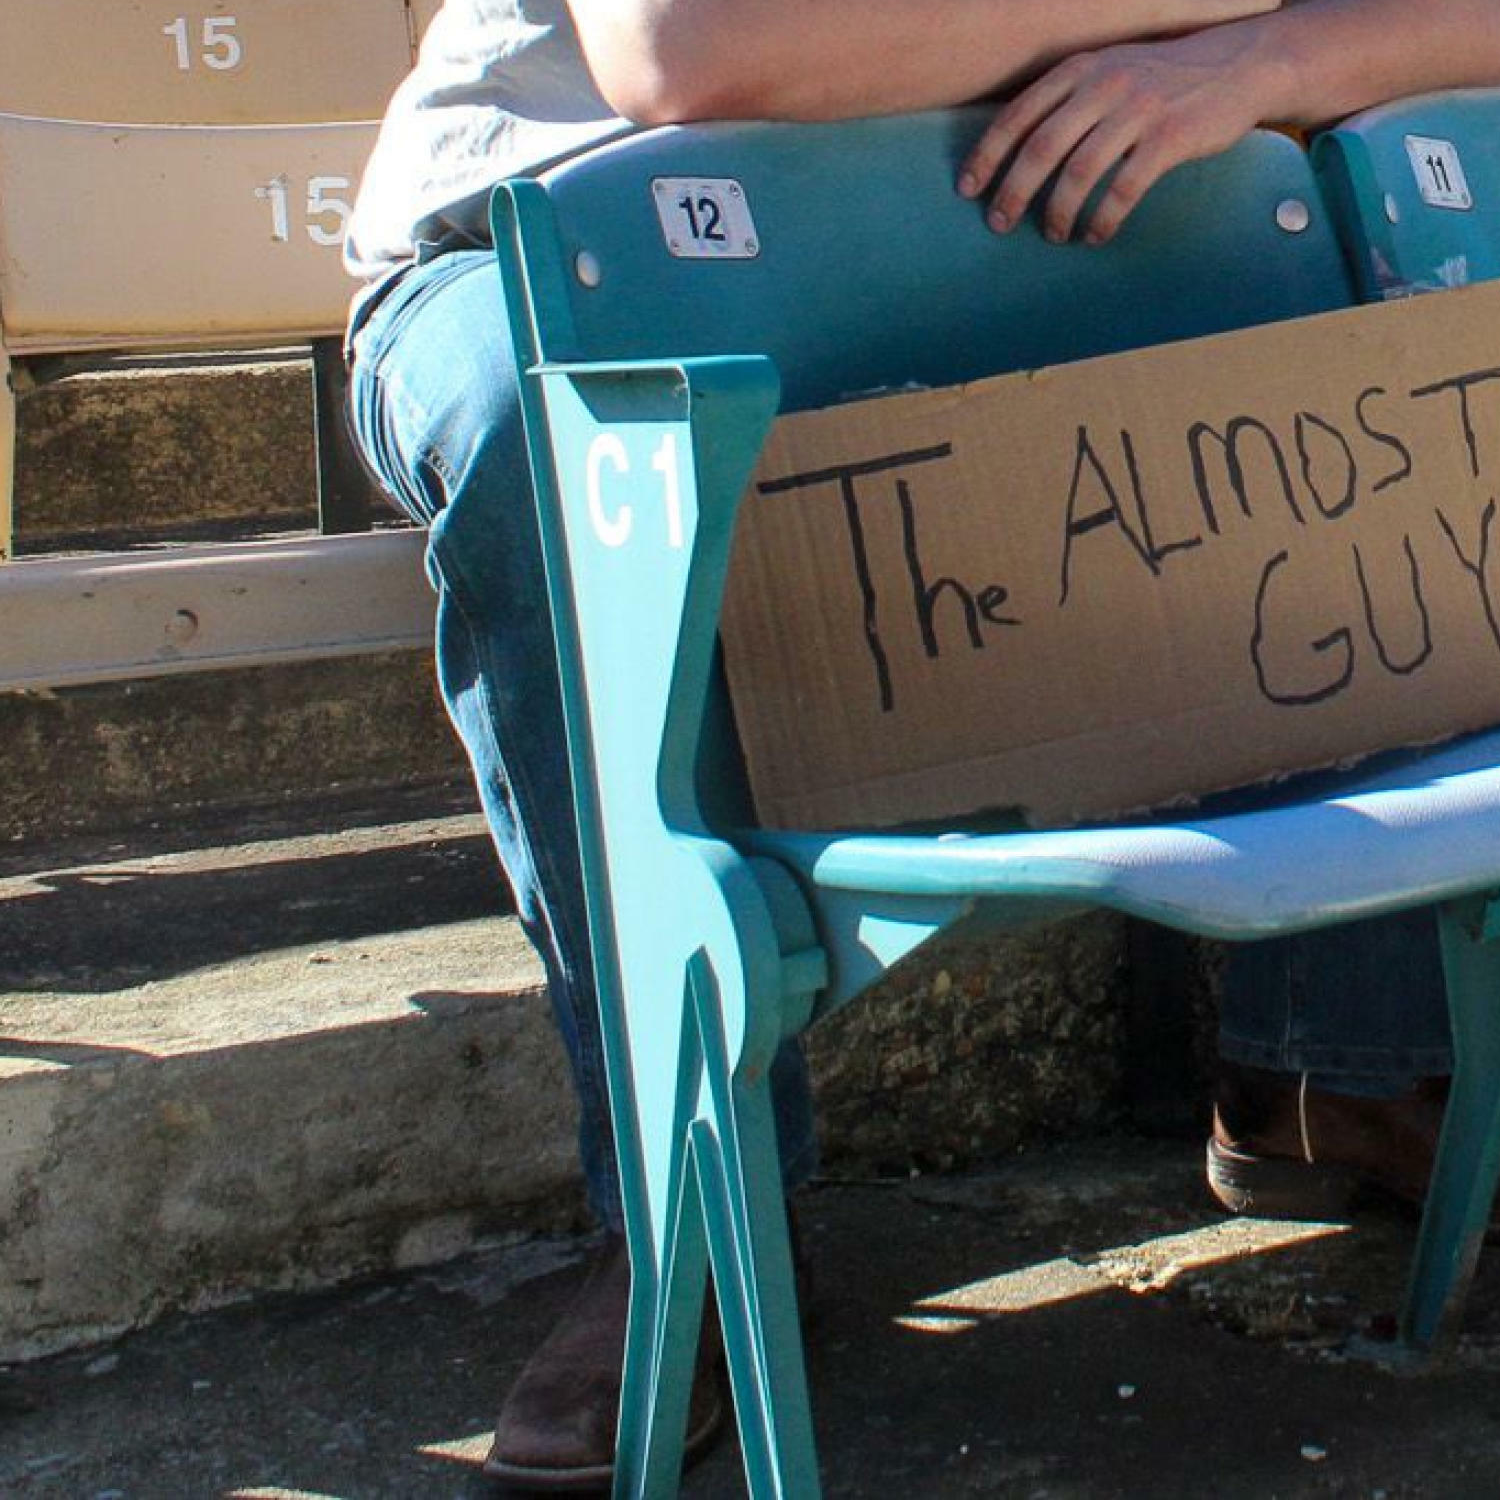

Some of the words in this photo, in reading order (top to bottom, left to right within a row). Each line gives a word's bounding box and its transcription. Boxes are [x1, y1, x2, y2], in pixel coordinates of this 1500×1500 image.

[162, 14, 243, 71] 15
[1425, 154, 1452, 193] 11
[253, 172, 354, 246] 15
[678, 195, 726, 242] 12
[756, 442, 1022, 713] The
